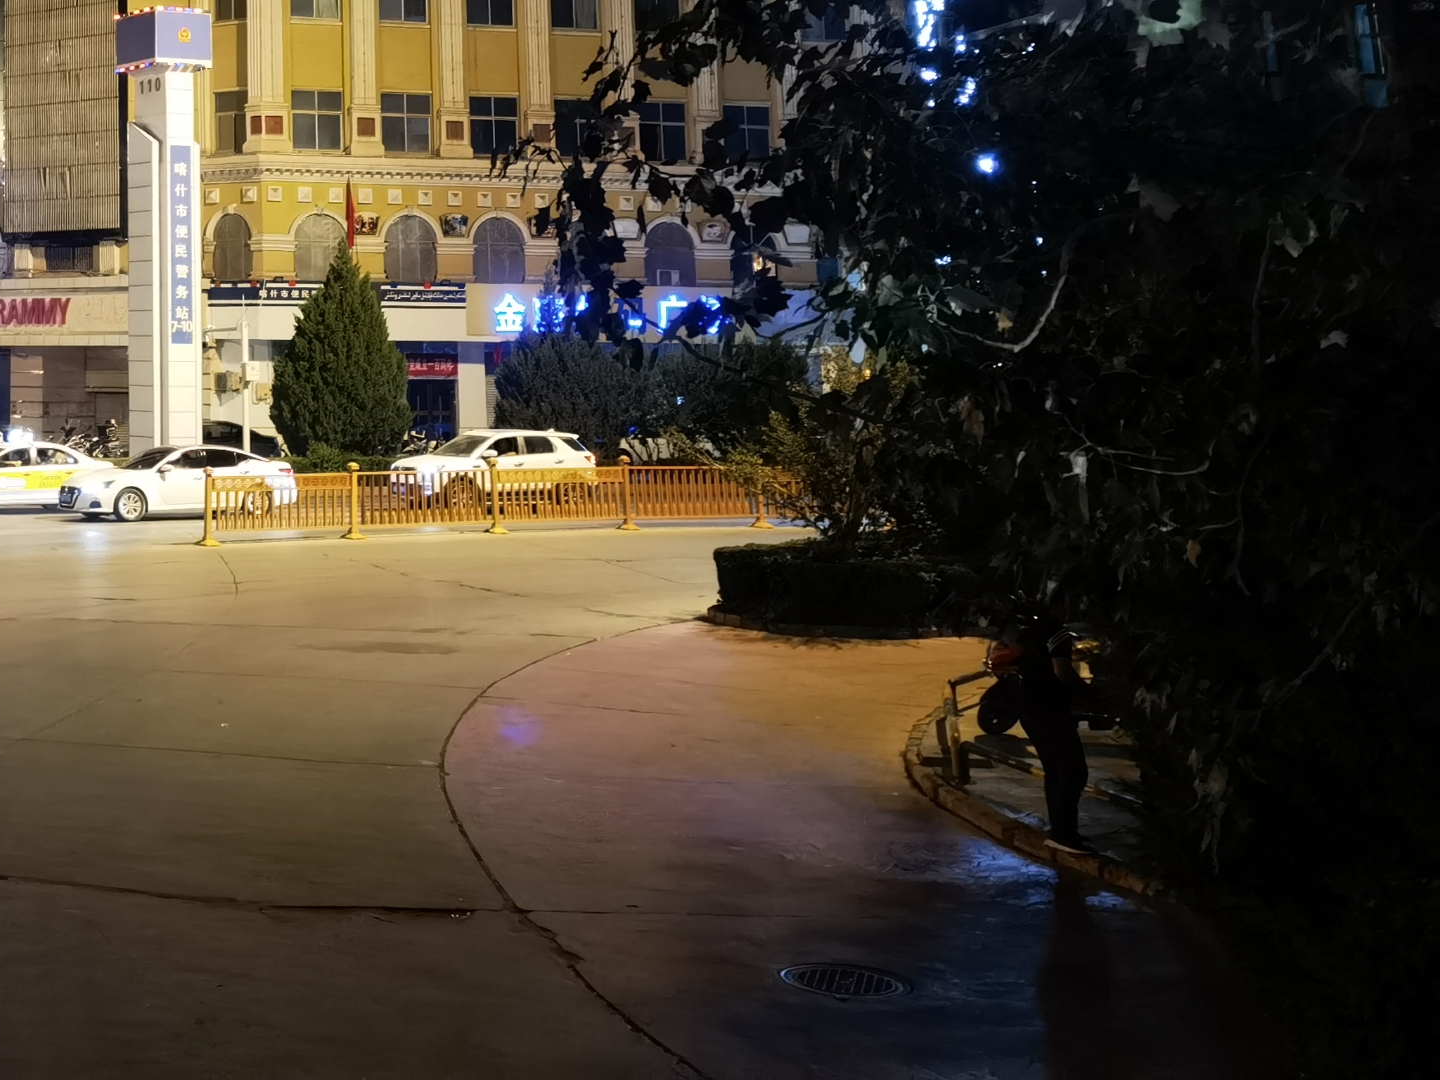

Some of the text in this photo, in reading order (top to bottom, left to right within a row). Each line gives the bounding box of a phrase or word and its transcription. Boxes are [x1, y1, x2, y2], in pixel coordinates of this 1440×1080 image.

[140, 77, 161, 94] 110
[173, 162, 189, 320] 喀什市便民警务站
